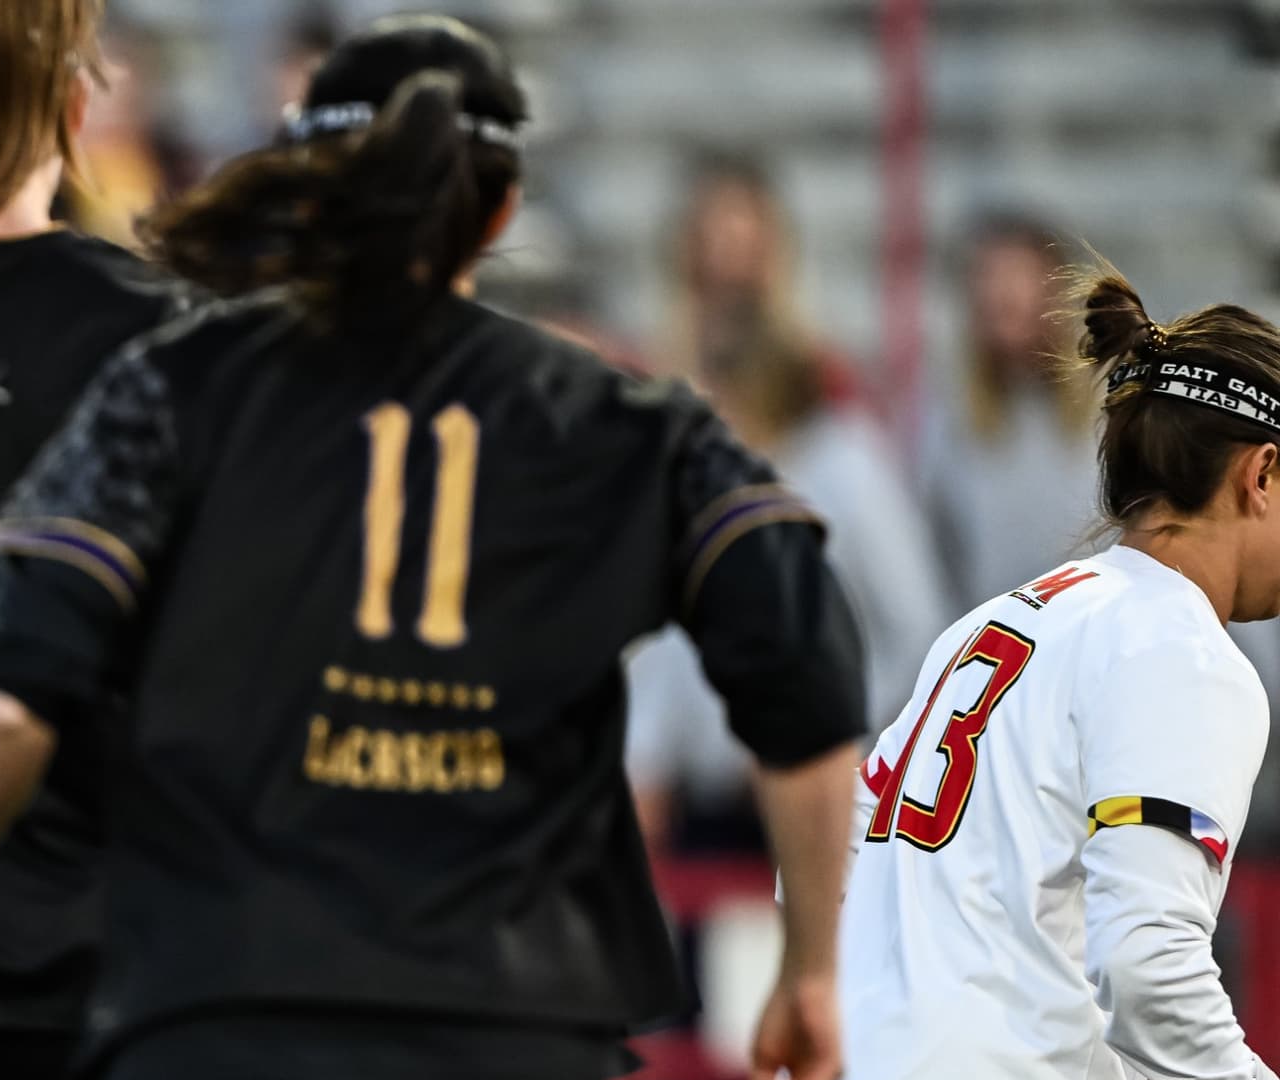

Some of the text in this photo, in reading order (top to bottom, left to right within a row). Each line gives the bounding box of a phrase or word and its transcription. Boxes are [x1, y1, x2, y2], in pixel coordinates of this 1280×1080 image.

[1159, 363, 1219, 383] GAIT
[1228, 377, 1280, 412] GAIT
[357, 402, 480, 648] 11
